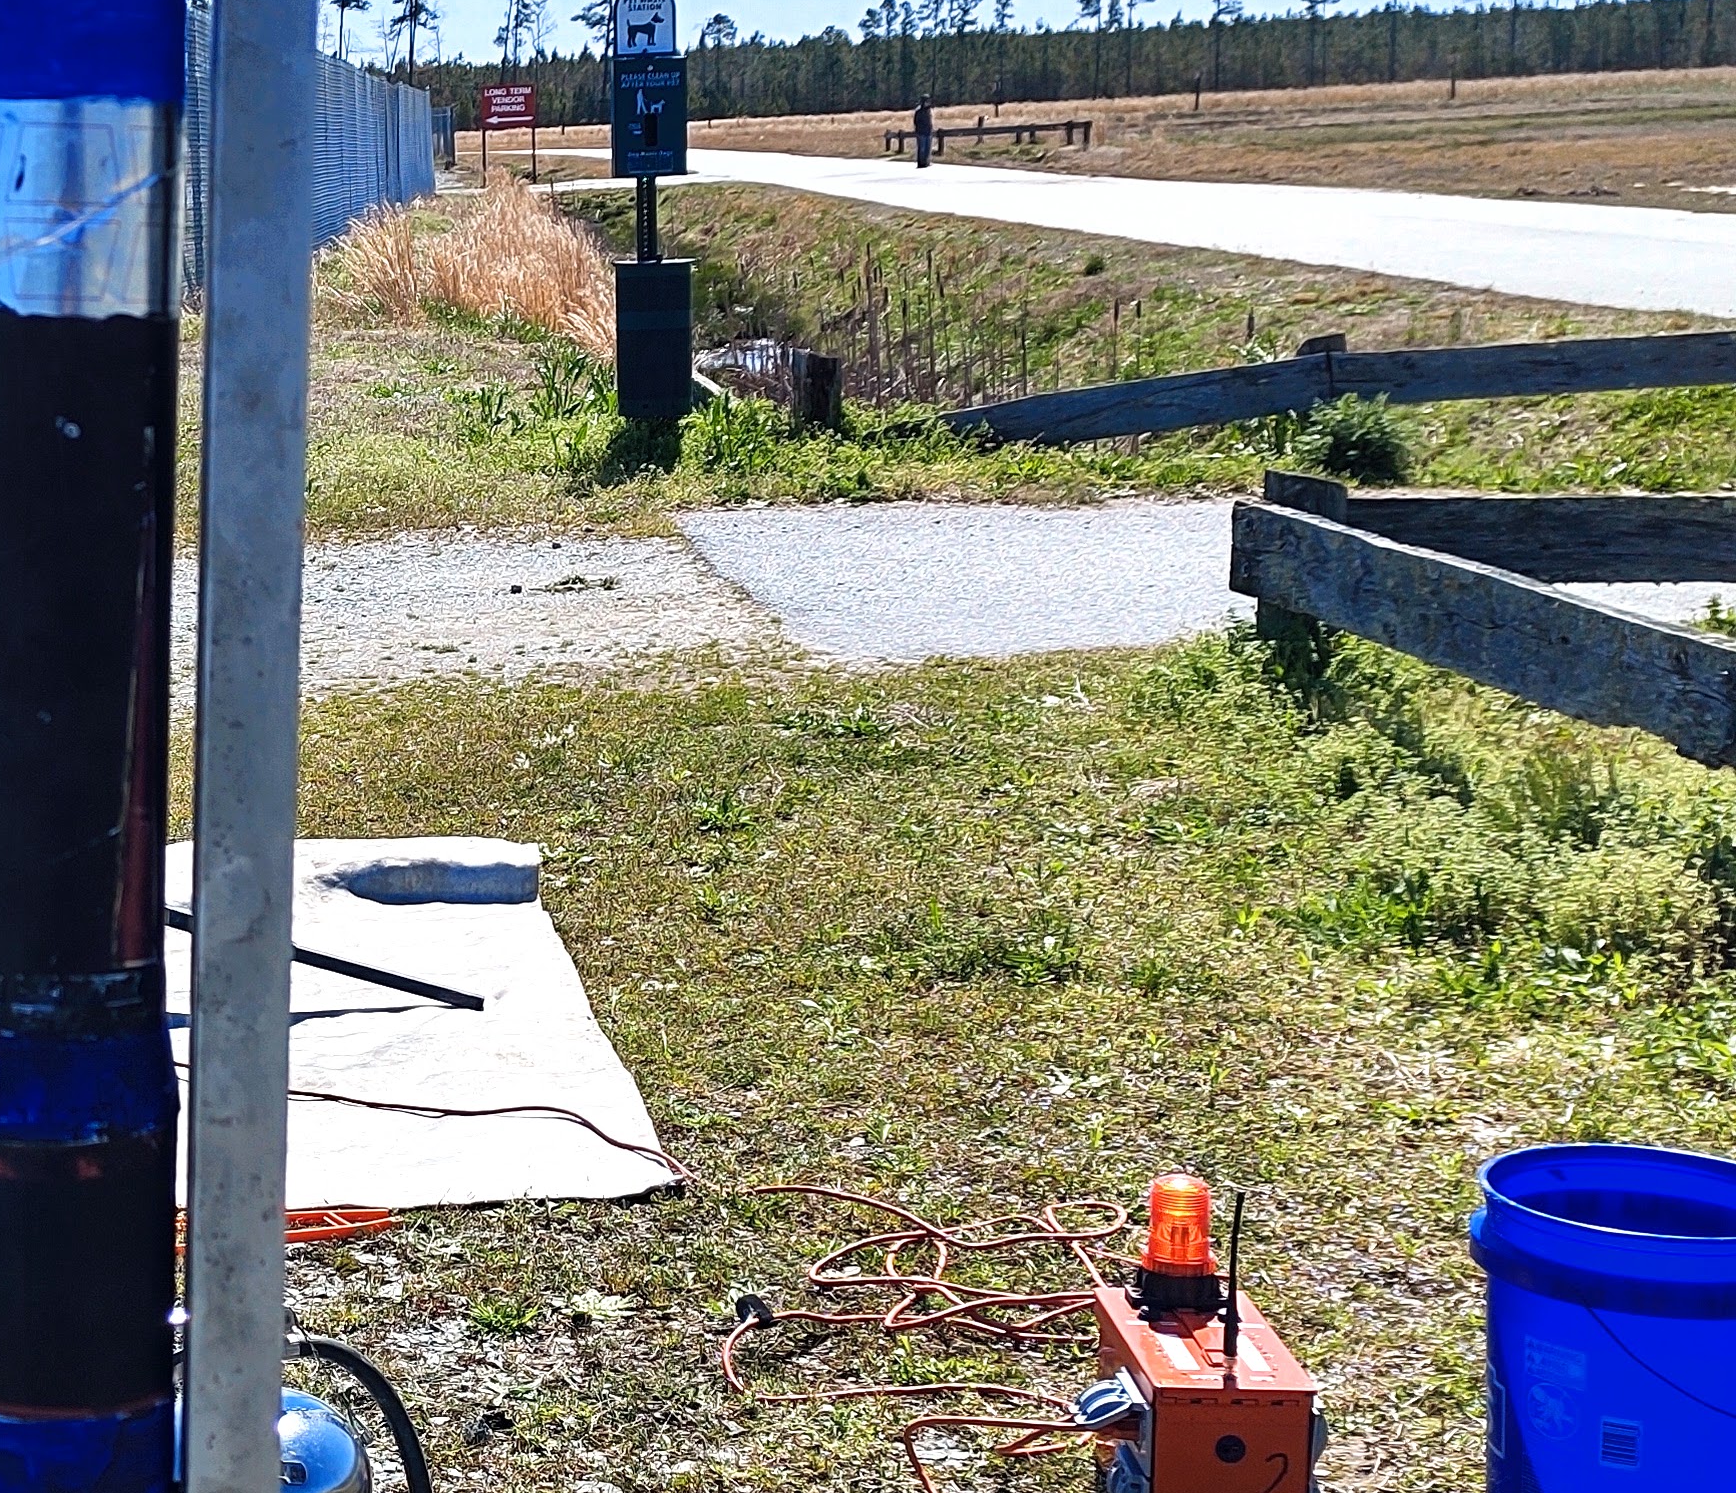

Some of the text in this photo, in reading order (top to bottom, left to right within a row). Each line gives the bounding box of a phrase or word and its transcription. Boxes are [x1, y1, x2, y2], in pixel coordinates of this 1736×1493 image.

[628, 3, 663, 12] STATION
[484, 86, 532, 97] LONG TERM
[491, 95, 525, 104] VENDOR
[491, 104, 526, 113] PARKING
